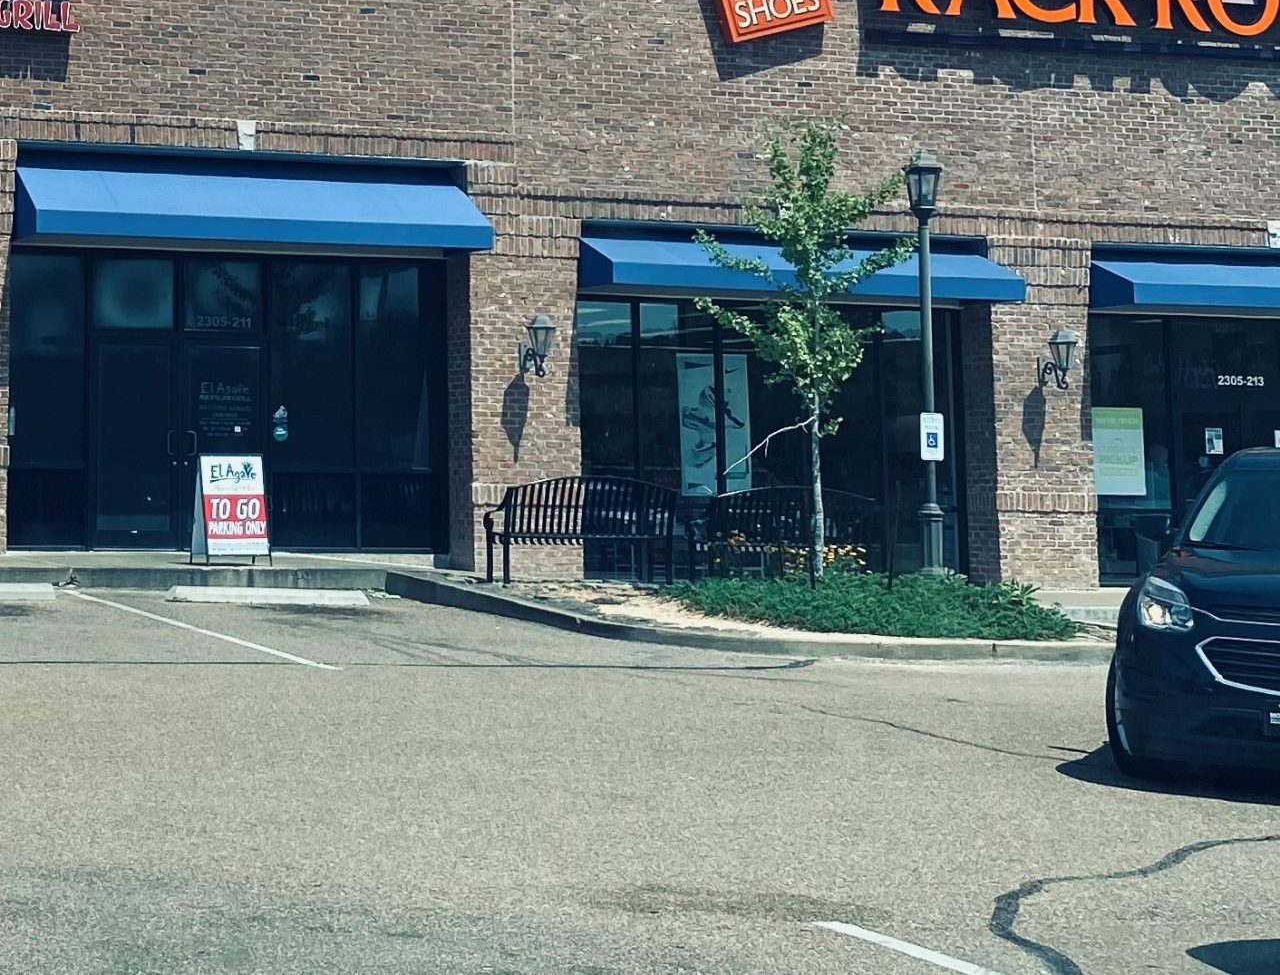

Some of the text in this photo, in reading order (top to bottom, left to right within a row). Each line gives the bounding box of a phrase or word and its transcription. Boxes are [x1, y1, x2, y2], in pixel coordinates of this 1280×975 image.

[196, 315, 252, 329] 2305-211
[1217, 375, 1265, 387] 2305-213
[210, 460, 257, 483] El Agave
[209, 497, 260, 520] TO GO
[208, 520, 267, 536] PARKING ONLY
